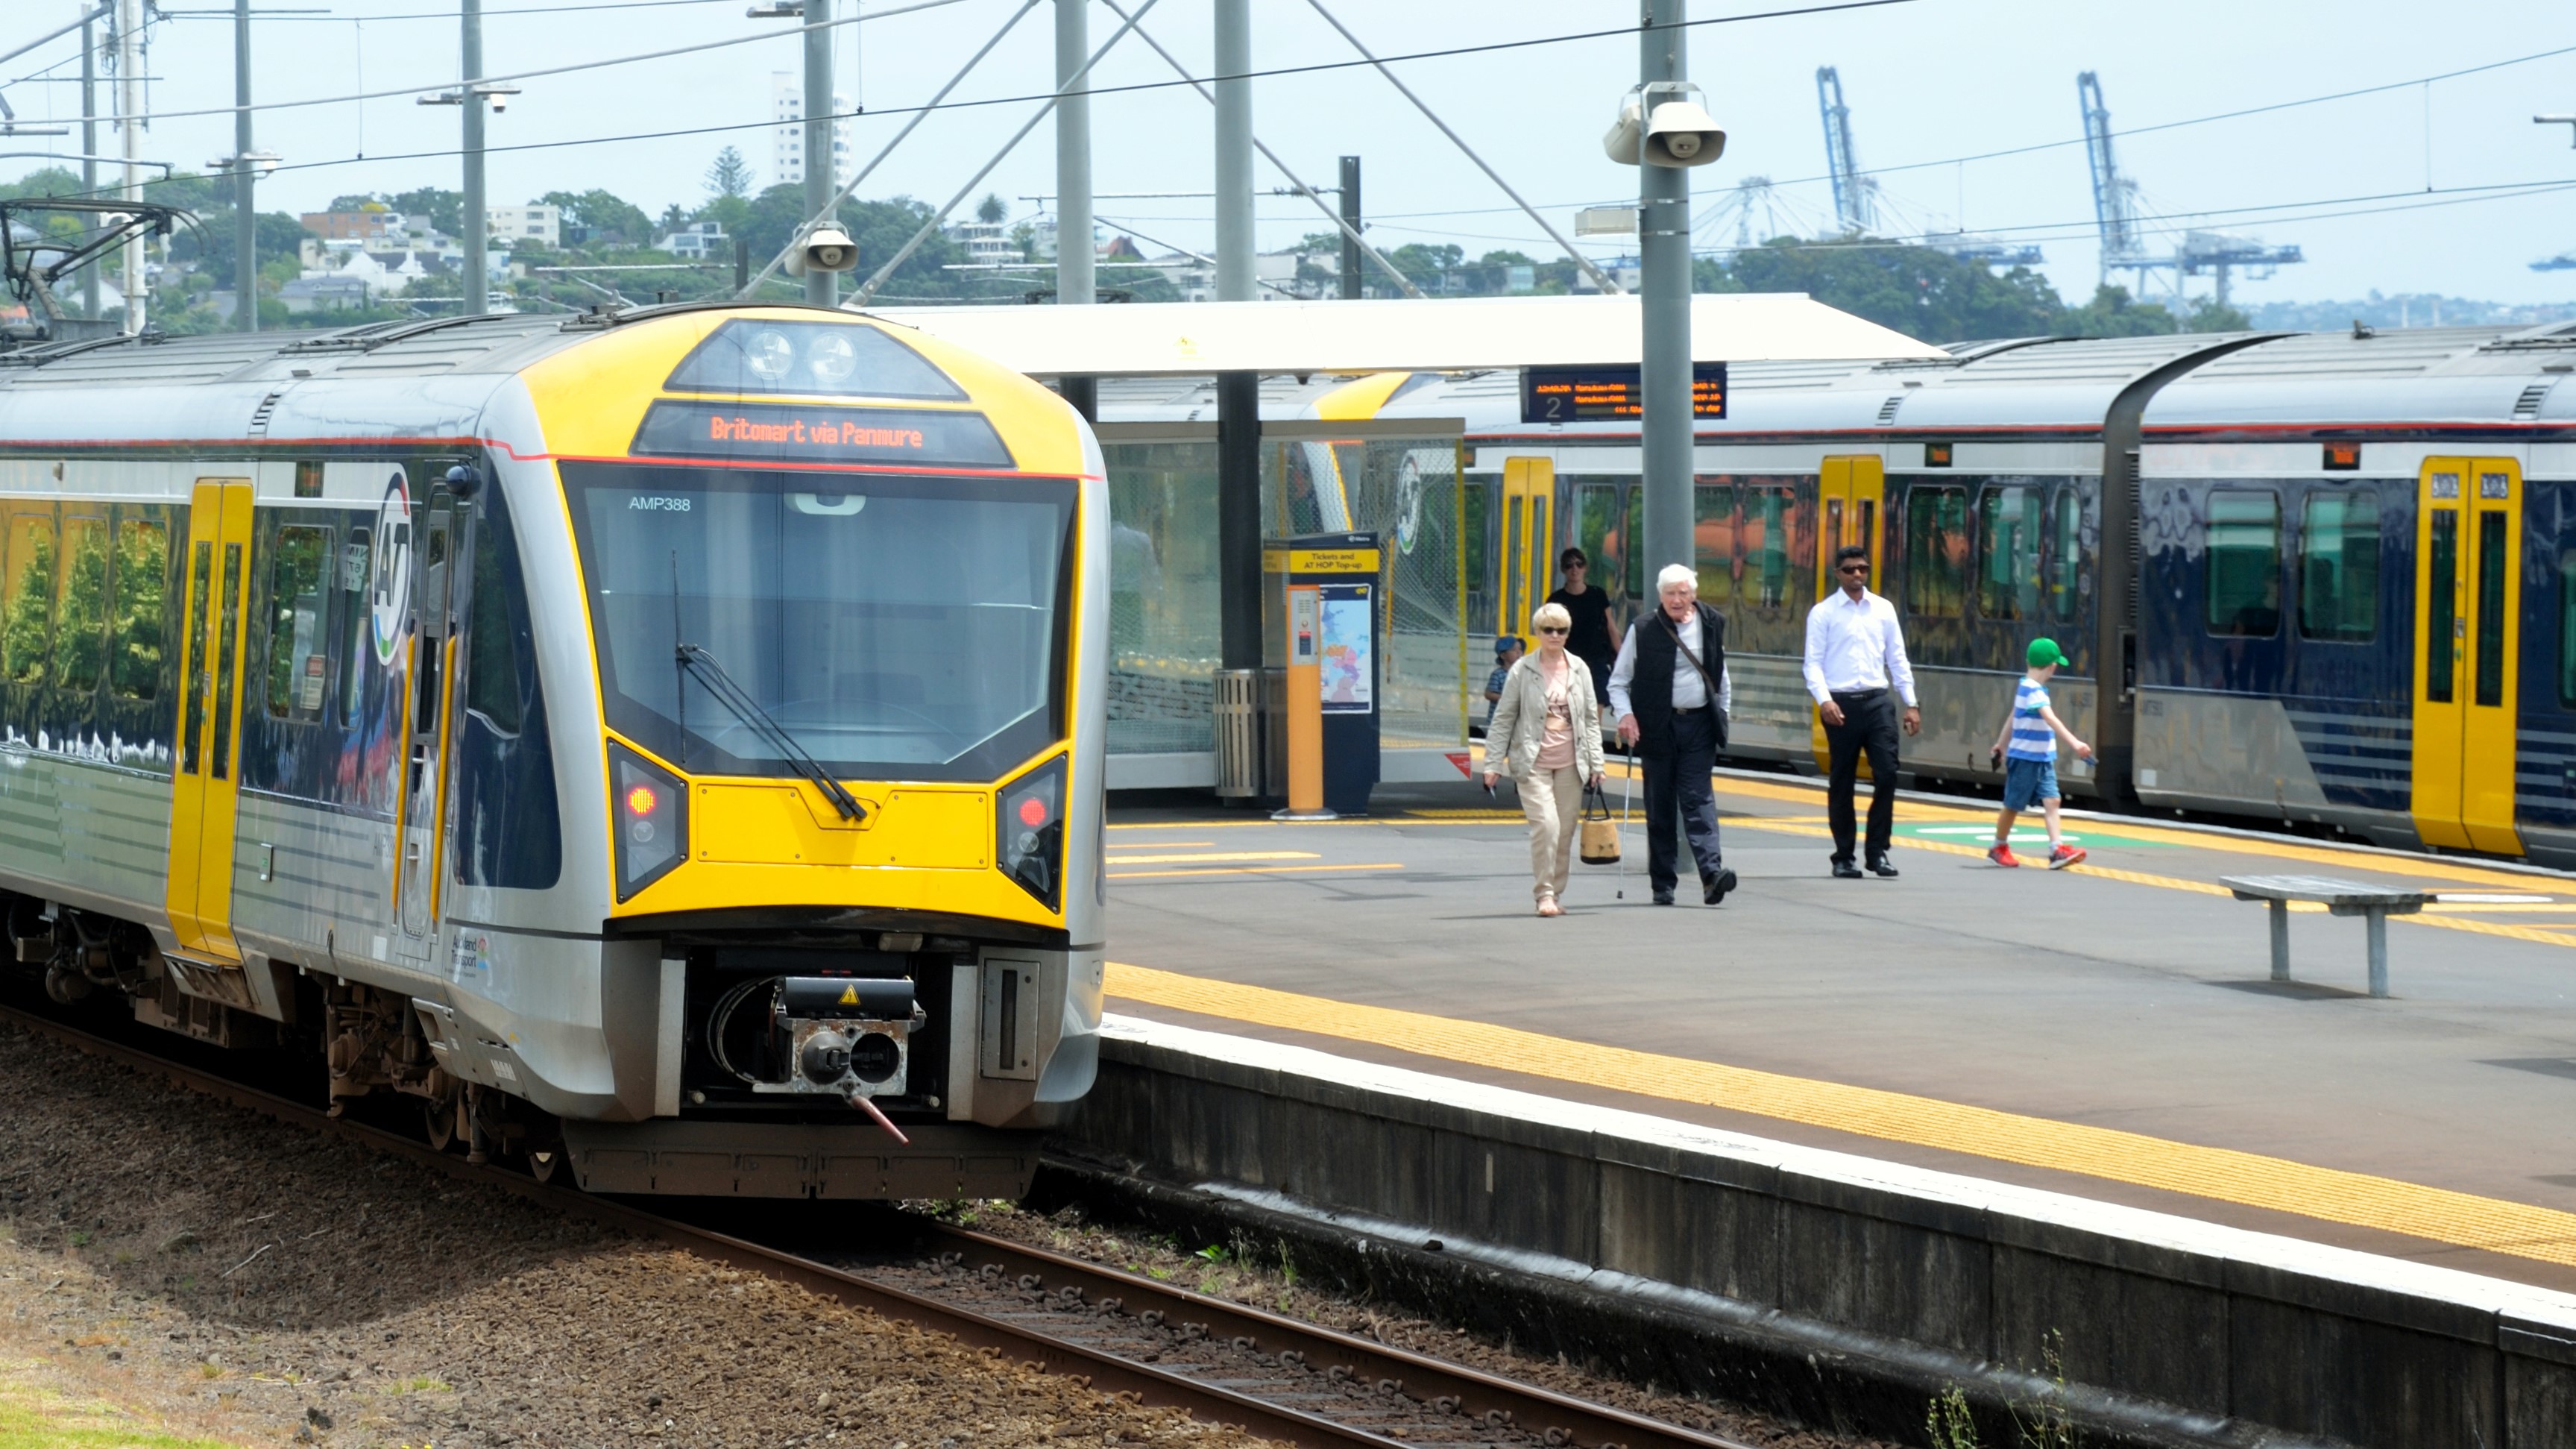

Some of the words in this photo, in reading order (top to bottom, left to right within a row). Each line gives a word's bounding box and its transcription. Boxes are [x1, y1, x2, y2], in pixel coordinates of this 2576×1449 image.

[1546, 397, 1561, 418] 2
[711, 416, 806, 443] Britomart
[810, 421, 838, 444] via
[842, 421, 923, 447] Panmure
[629, 497, 690, 512] AMP388
[374, 522, 410, 607] AT
[1337, 562, 1363, 570] Top-up
